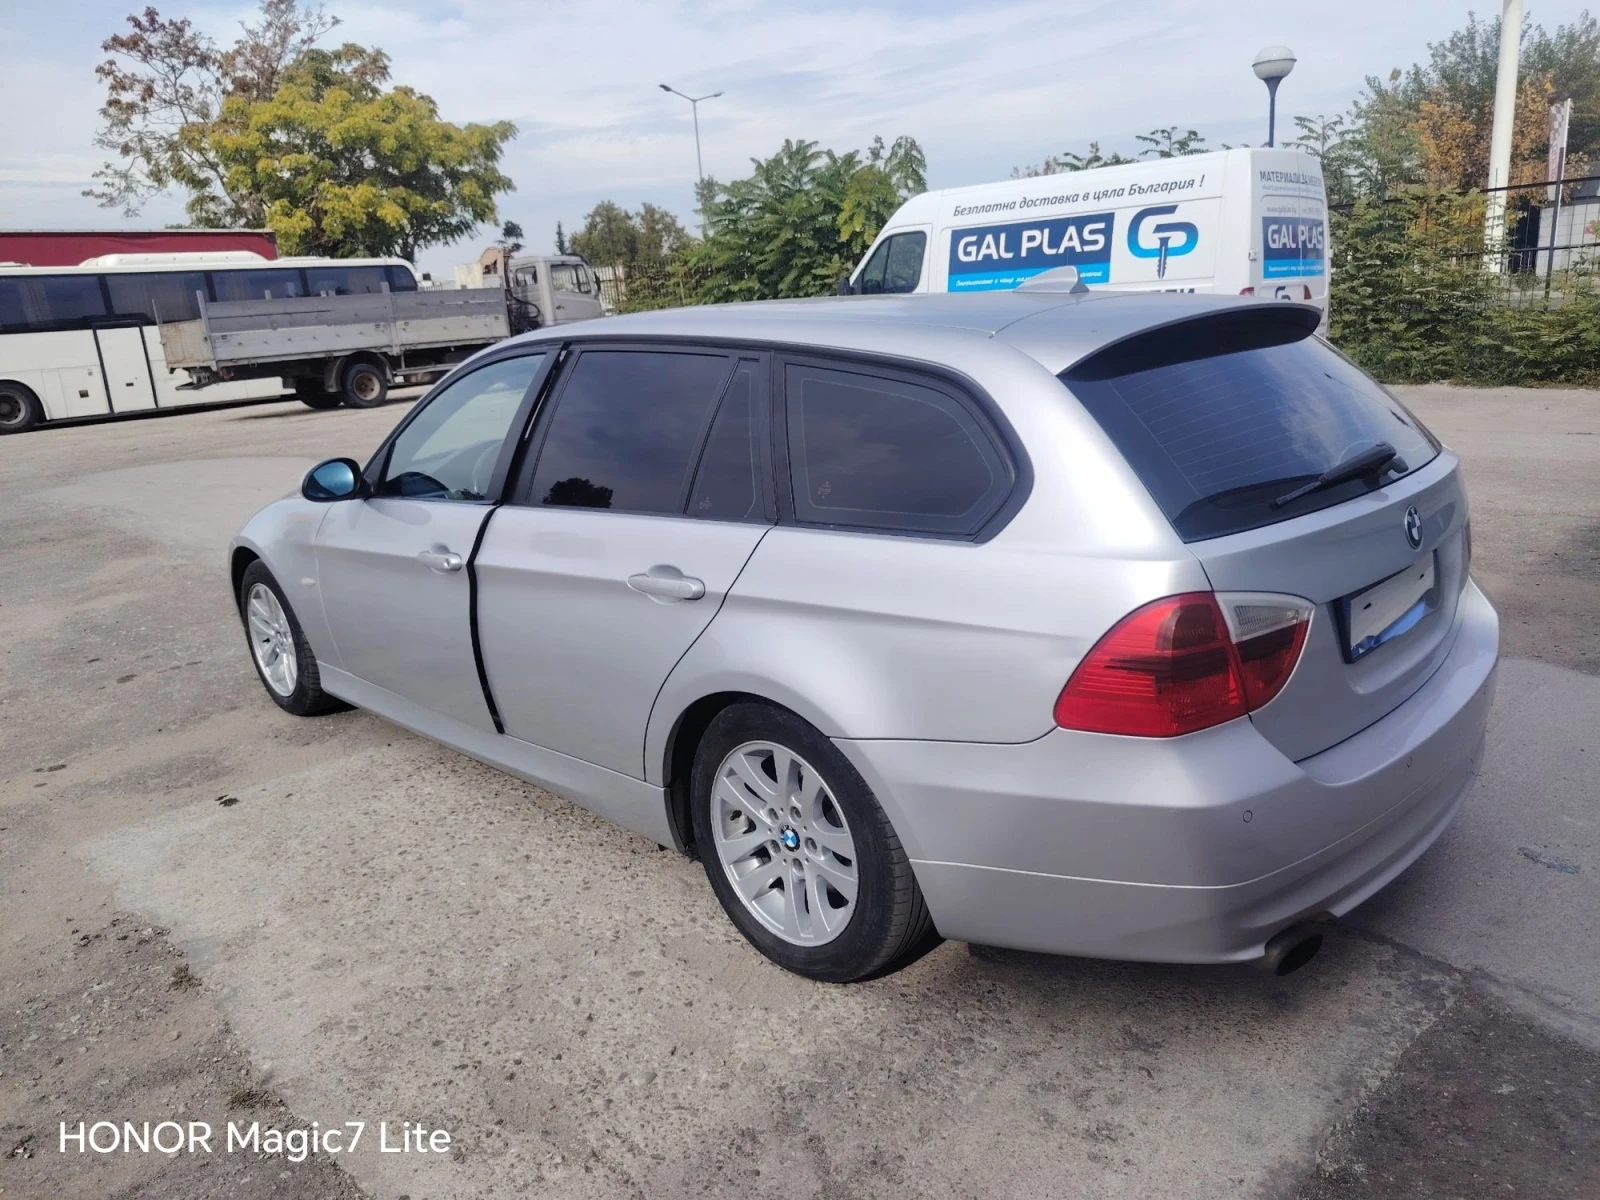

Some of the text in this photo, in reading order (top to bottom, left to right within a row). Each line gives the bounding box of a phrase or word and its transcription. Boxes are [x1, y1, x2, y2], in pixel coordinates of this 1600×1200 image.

[953, 200, 1016, 217] Безплатна
[1019, 192, 1079, 210] доставка
[1082, 192, 1090, 202] в
[1093, 187, 1125, 202] цяла
[1128, 178, 1195, 196] България
[957, 222, 1106, 262] GAL PLAS
[1267, 224, 1323, 249] GAL PLAS
